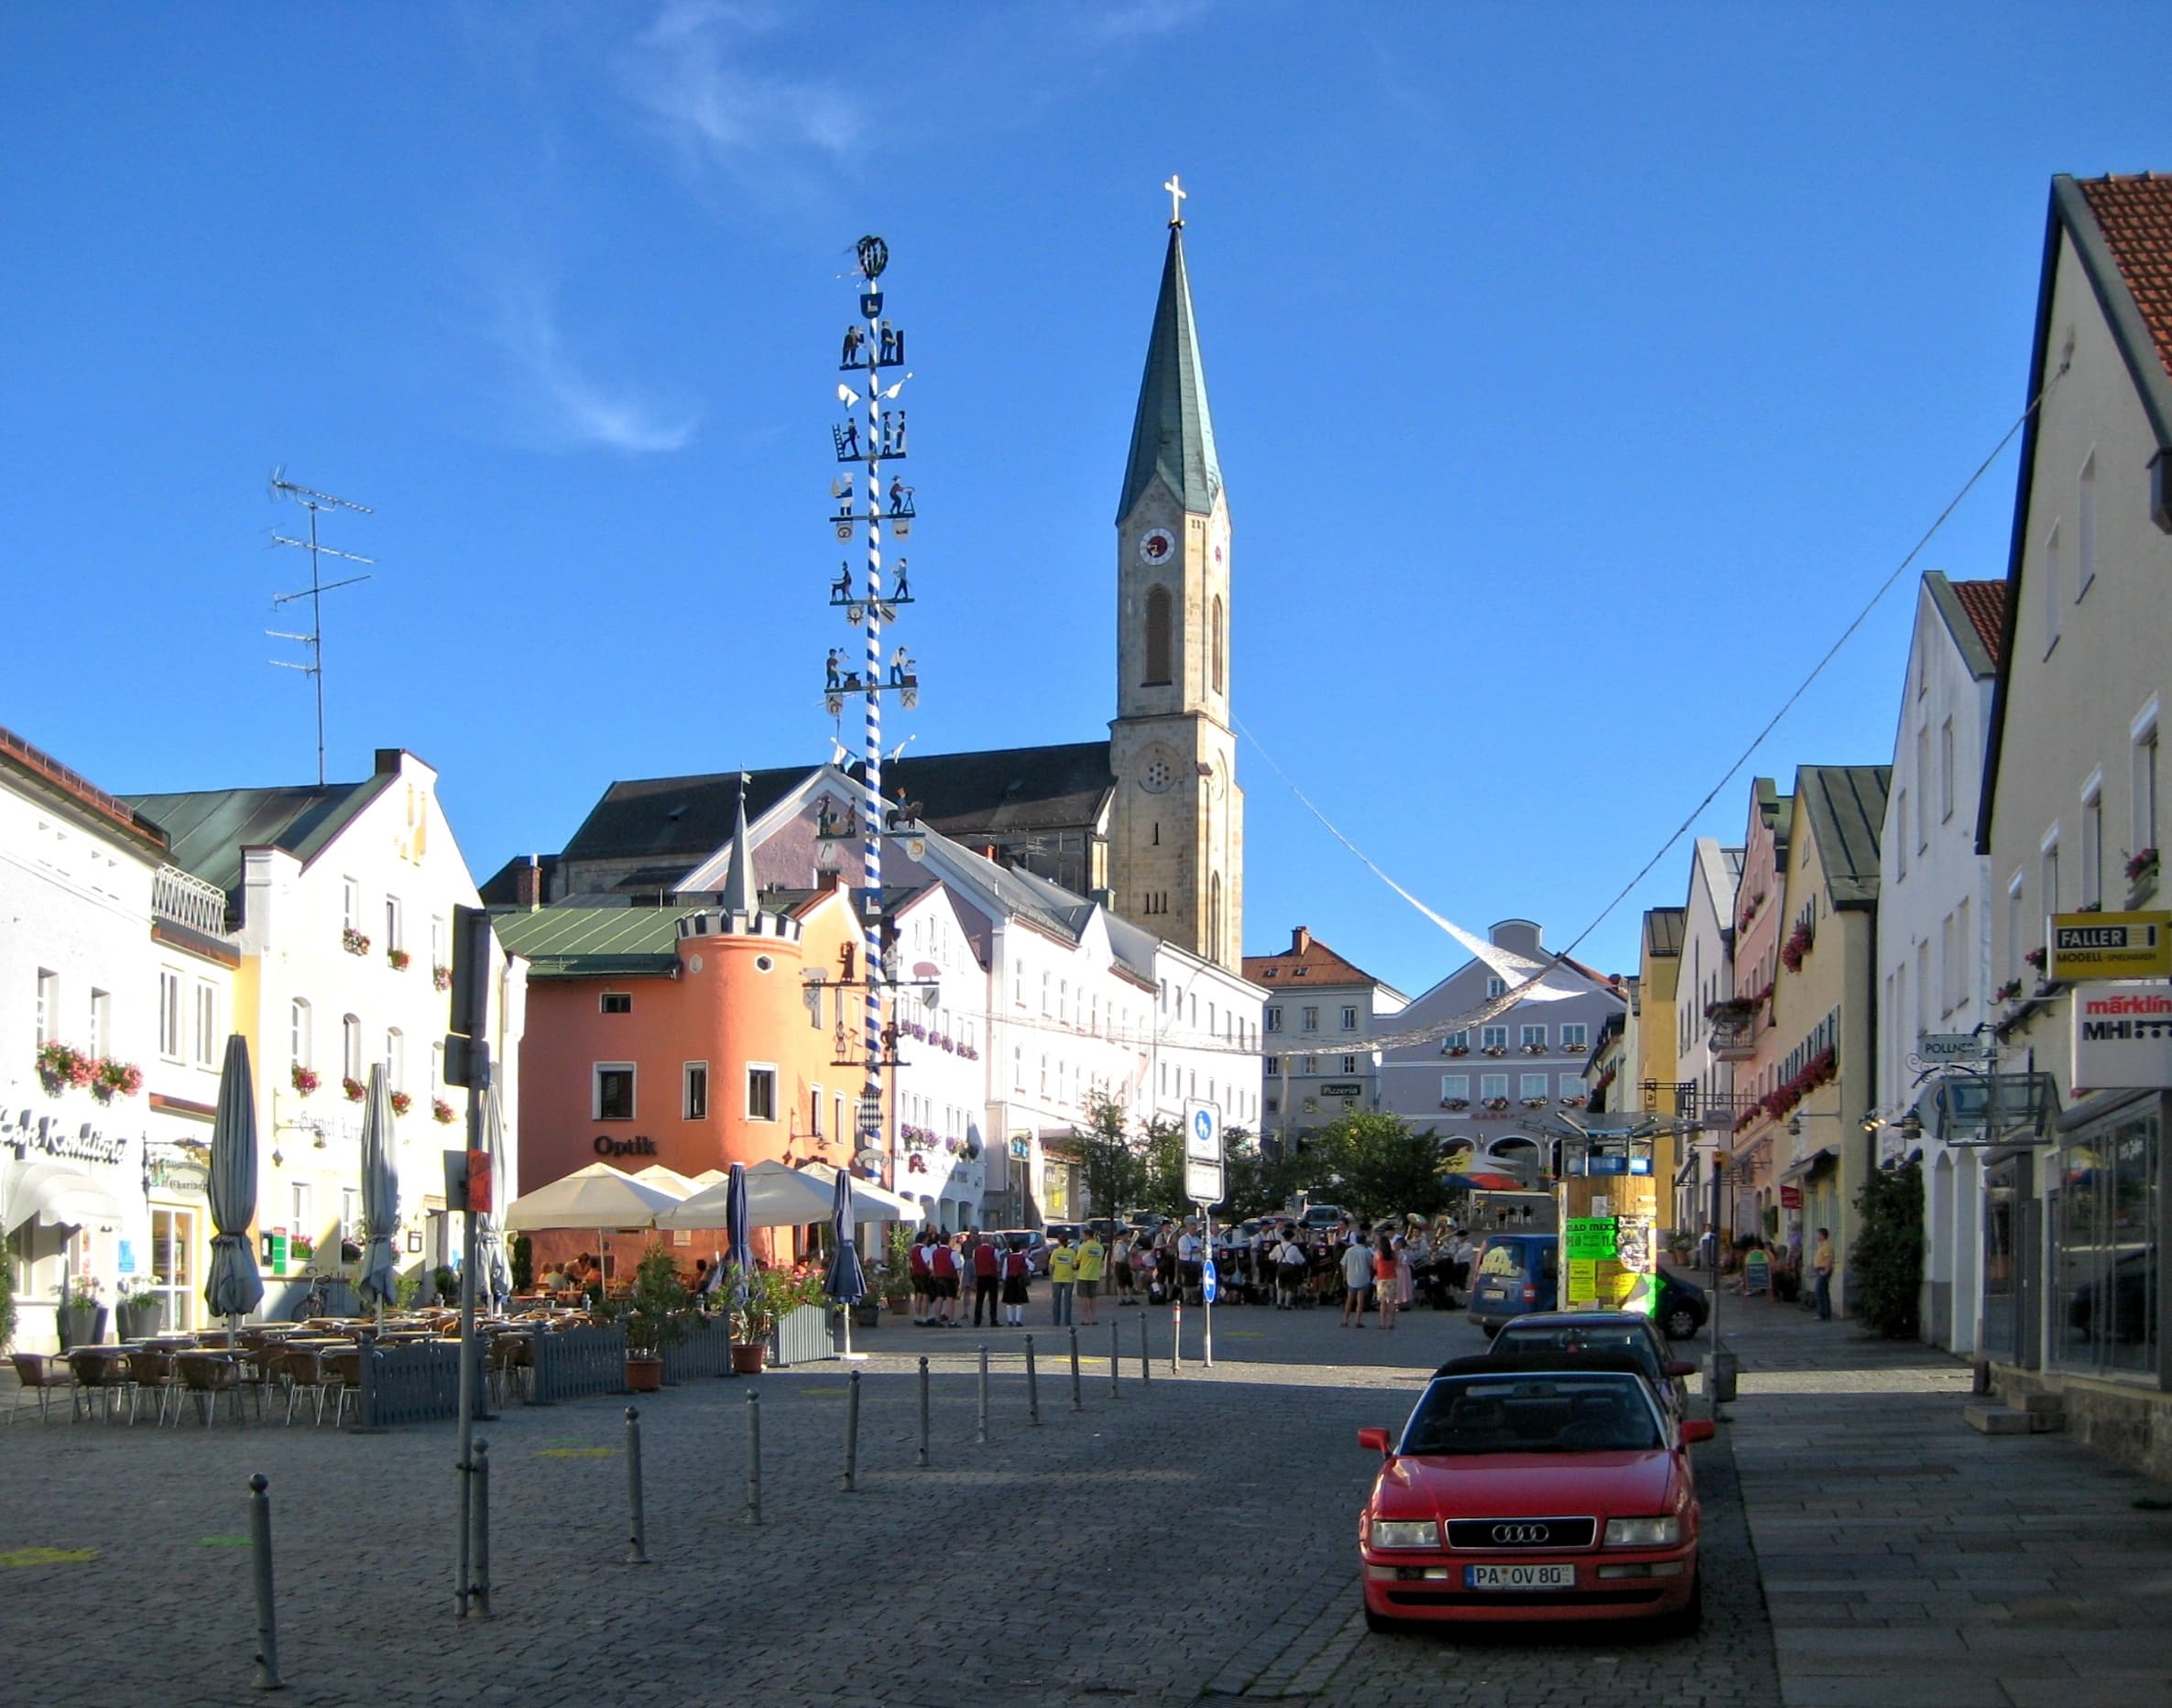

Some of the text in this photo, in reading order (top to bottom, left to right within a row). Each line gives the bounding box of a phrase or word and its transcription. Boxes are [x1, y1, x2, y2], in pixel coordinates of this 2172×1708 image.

[2061, 930, 2123, 947] FALLER
[2083, 1020, 2132, 1040] MHI
[594, 1136, 658, 1157] Optik
[1476, 1568, 1499, 1583] PA
[1512, 1568, 1534, 1583] OV
